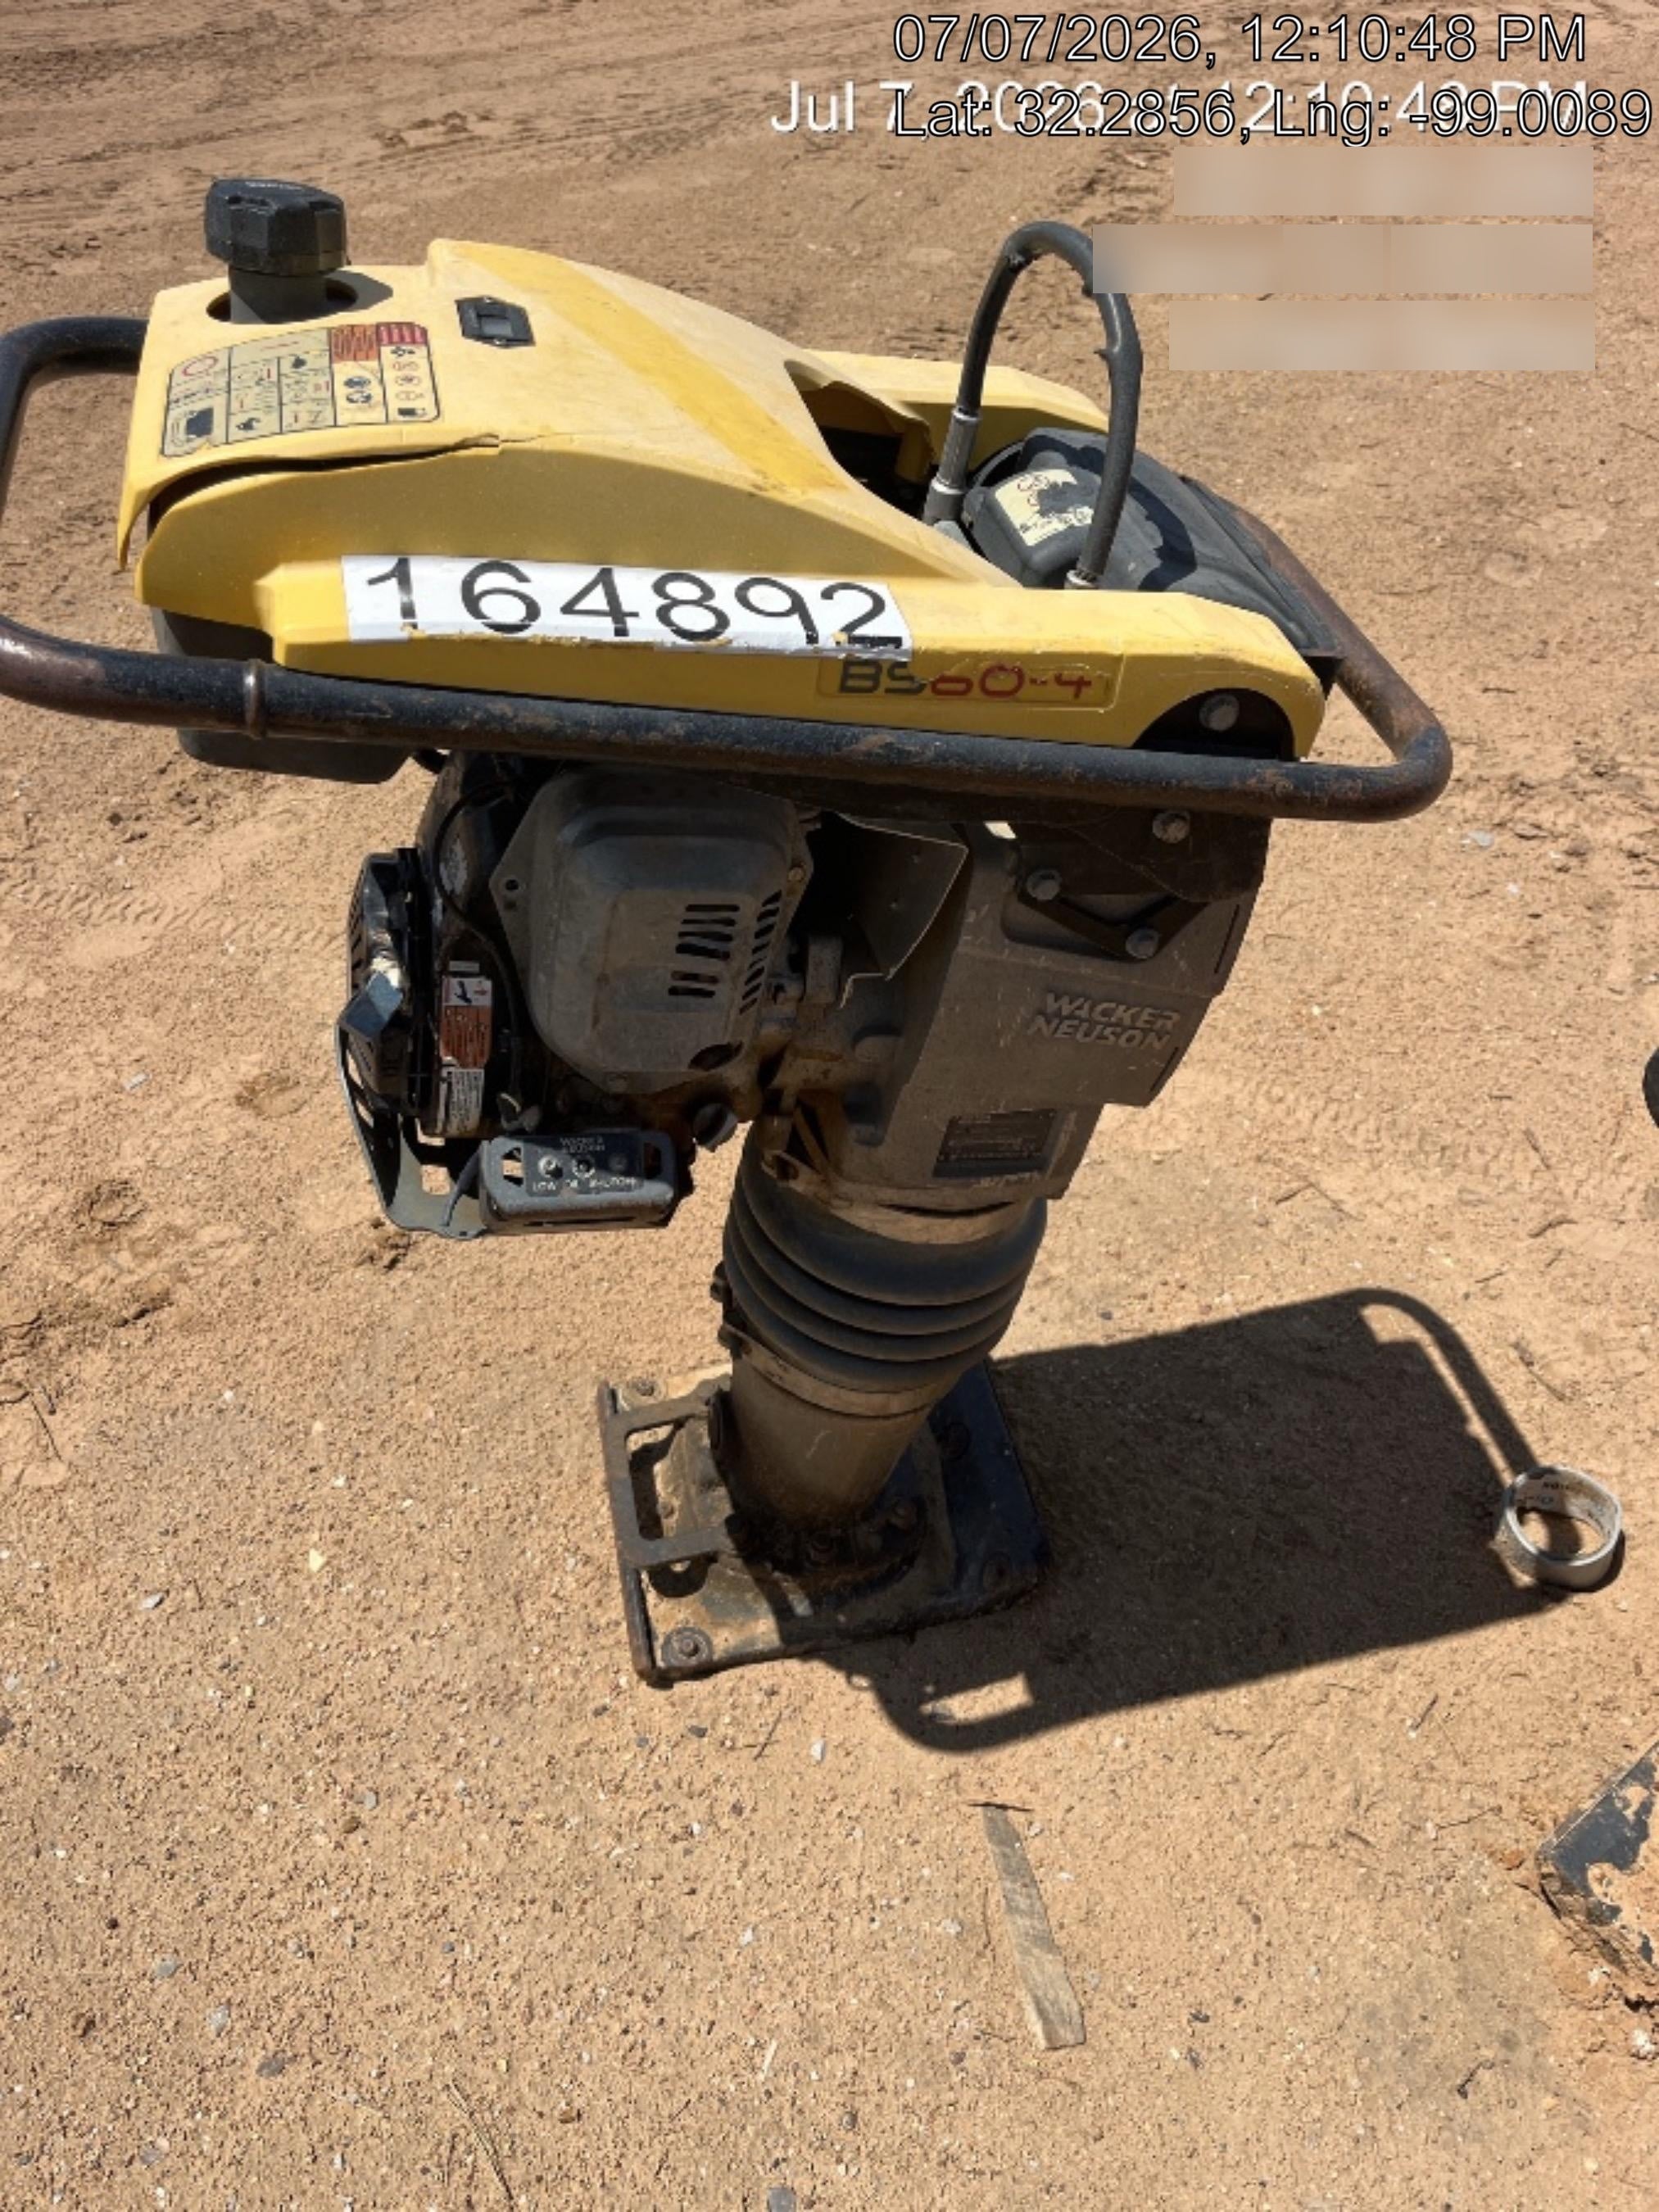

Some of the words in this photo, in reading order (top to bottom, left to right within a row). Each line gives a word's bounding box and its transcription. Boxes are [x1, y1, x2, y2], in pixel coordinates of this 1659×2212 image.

[367, 557, 904, 650] 164892
[1027, 1014, 1171, 1050] NEUSON
[1044, 992, 1181, 1033] WACKER
